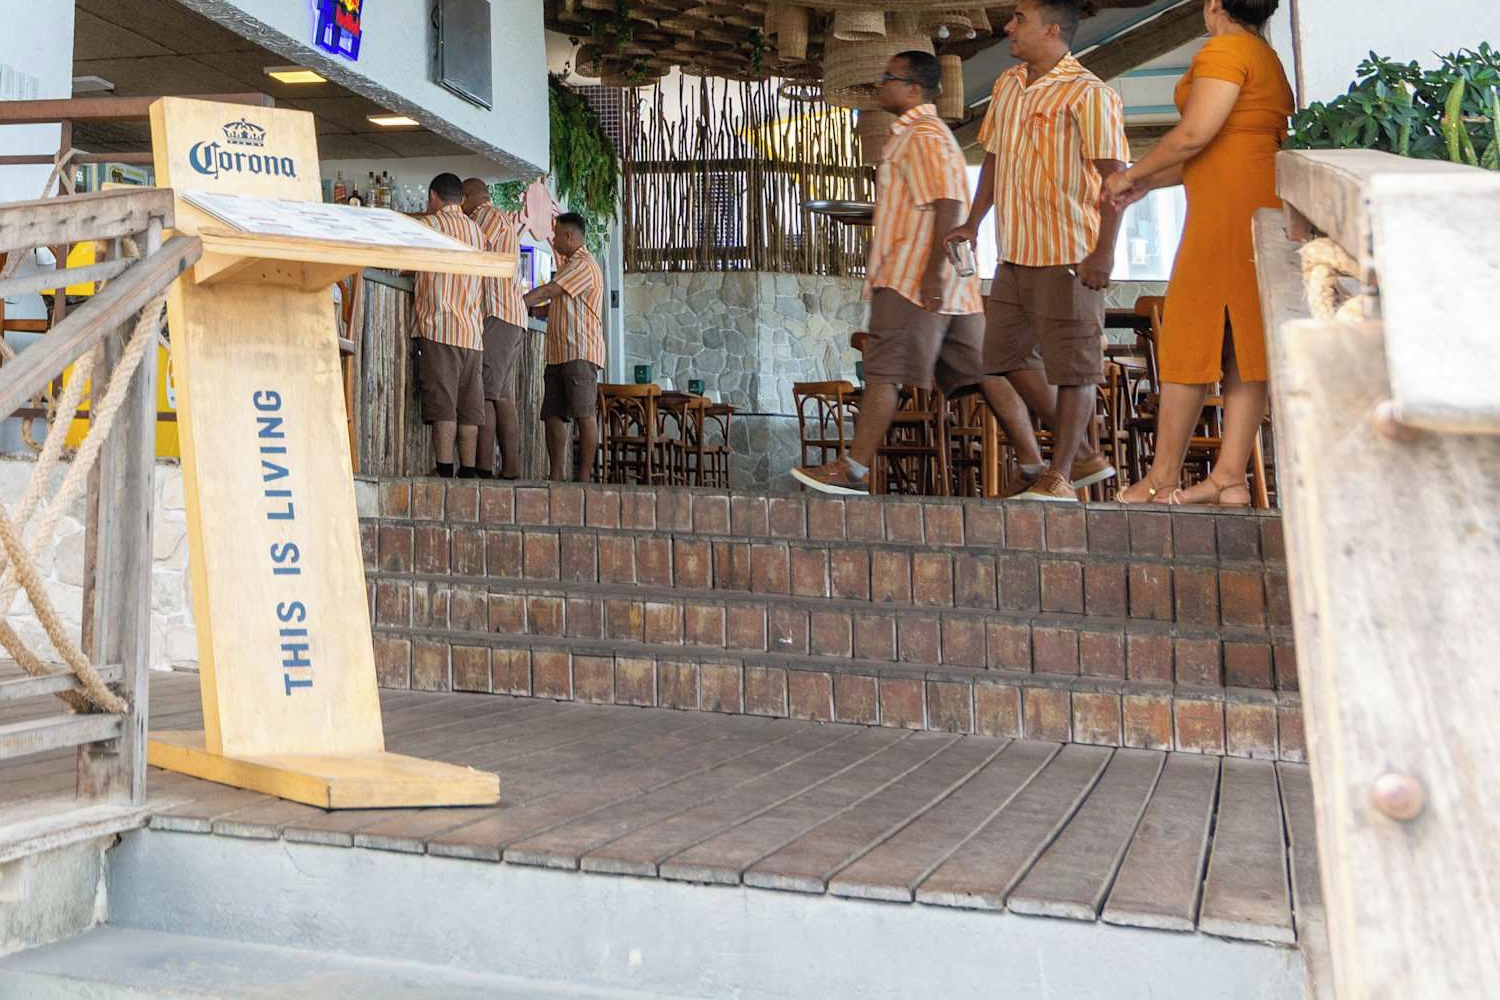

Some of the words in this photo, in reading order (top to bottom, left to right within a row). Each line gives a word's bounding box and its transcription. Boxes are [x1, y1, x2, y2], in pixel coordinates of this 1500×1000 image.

[189, 140, 297, 180] Corona
[252, 389, 295, 521] LIVING
[270, 541, 302, 575] IS
[276, 600, 313, 697] THIS
